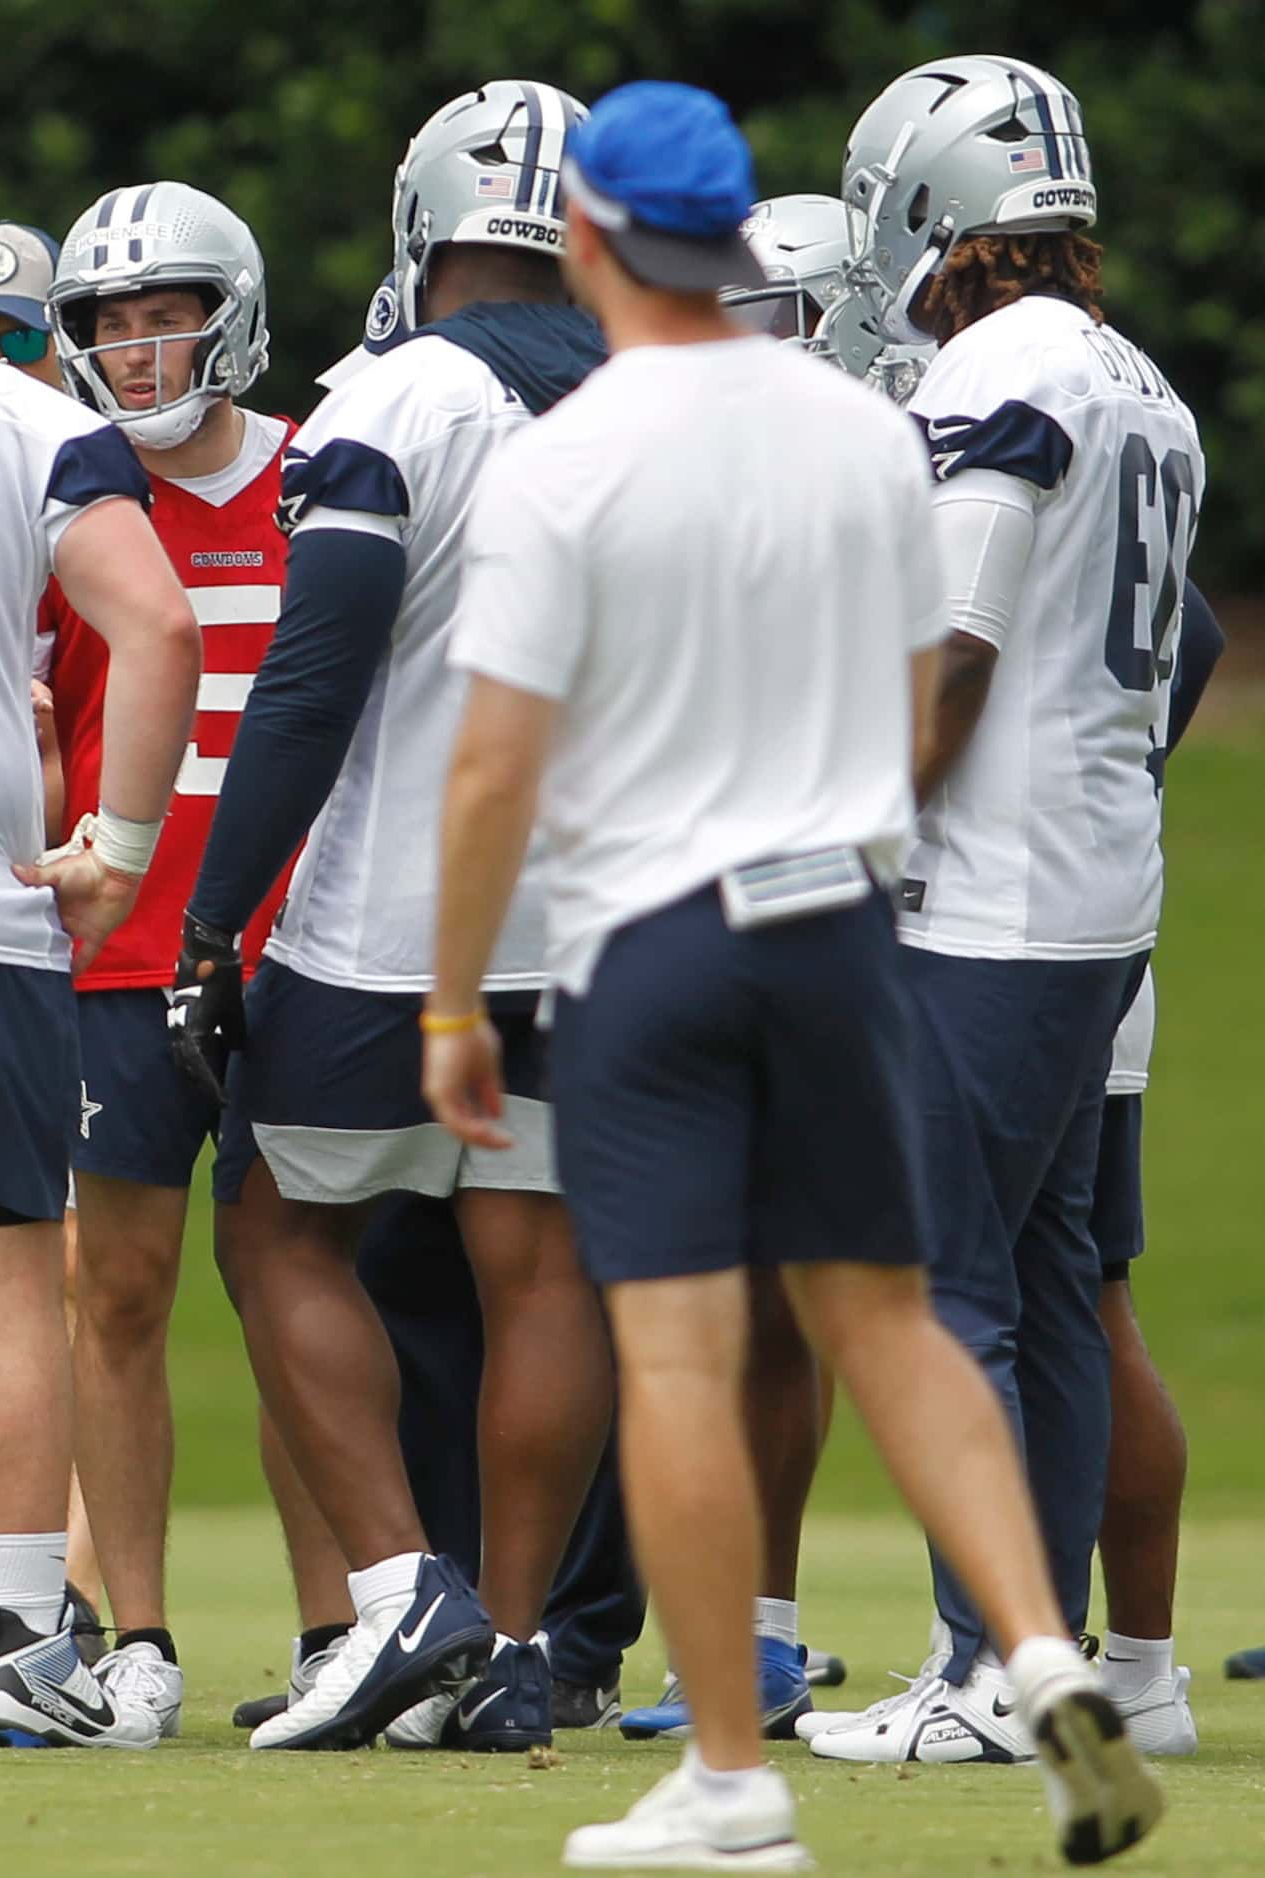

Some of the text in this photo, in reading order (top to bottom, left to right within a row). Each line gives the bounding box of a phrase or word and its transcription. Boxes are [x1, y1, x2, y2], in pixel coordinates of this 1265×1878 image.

[191, 552, 263, 567] COWBOYS
[32, 1695, 76, 1727] FORCE
[924, 1726, 973, 1744] ALPHA
